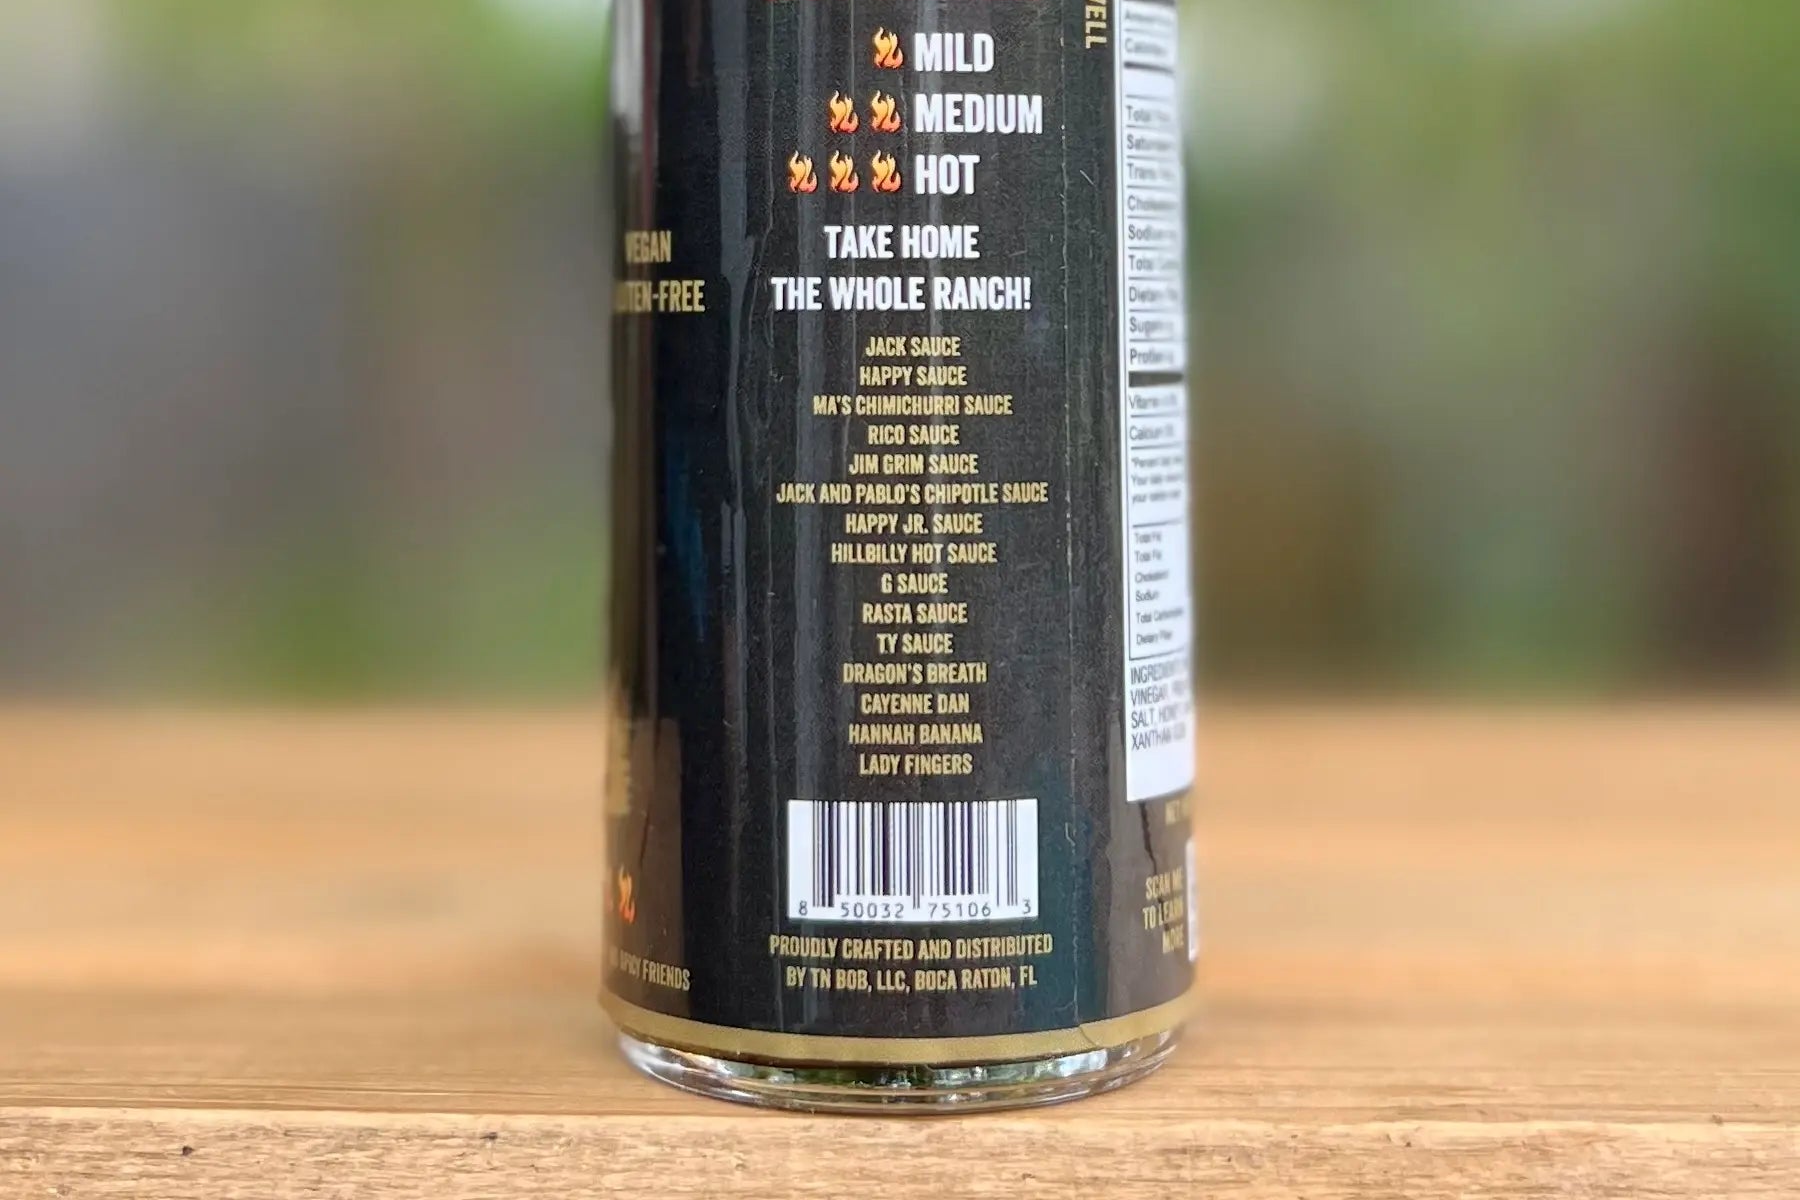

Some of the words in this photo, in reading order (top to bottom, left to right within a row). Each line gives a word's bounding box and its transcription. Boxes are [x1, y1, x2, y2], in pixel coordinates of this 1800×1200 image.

[913, 31, 995, 73] MILD
[913, 92, 1043, 135] MEDIUM
[914, 153, 981, 195] HOT
[625, 230, 672, 263] VEGAN
[823, 224, 894, 259] TAKE
[900, 224, 981, 259] HOME
[770, 276, 823, 311] THE
[828, 275, 926, 311] WHOLE
[931, 275, 1031, 311] RANCH!
[865, 335, 907, 357] JACK
[910, 336, 960, 357] SAUCE
[859, 365, 913, 386] HAPPY
[916, 365, 967, 387] SAUCE
[813, 395, 852, 416] MA'S
[854, 394, 960, 416] CHIMICHURRI
[963, 394, 1012, 416] SAUCE
[867, 424, 906, 445] RICO
[908, 424, 960, 446] SAUCE
[849, 453, 879, 475] JIM
[882, 453, 924, 475] GRIM
[928, 453, 977, 475] SAUCE
[777, 483, 815, 504] JACK
[819, 483, 852, 504] AND
[855, 483, 921, 505] PABLO'S
[923, 483, 999, 505] CHIPOTLE
[1002, 482, 1047, 504] SAUCE
[845, 513, 899, 535] HAPPY
[902, 513, 929, 535] JR.
[932, 512, 983, 535] SAUCE
[831, 543, 908, 564] HILLBILLY
[911, 542, 944, 564] HOT
[947, 542, 998, 564] SAUCE
[881, 573, 893, 594] G
[896, 572, 949, 595] SAUCE
[862, 602, 913, 624] RASTA
[916, 602, 967, 624] SAUCE
[877, 633, 898, 653] TY
[901, 632, 953, 655] SAUCE
[843, 662, 923, 685] DRAGON'S
[926, 662, 987, 684] BREATH
[861, 693, 933, 715] CAYENNE
[936, 693, 970, 714] DAN
[848, 723, 915, 745] HANNAH
[919, 723, 983, 745] BANANA
[859, 753, 901, 775] LADY
[904, 753, 973, 775] FINGERS
[1146, 872, 1171, 901] SCAN
[798, 901, 808, 916] 8
[840, 902, 904, 919] 50032
[928, 902, 992, 918] 75106
[1022, 899, 1032, 915] 3
[1143, 906, 1157, 931] TO
[770, 935, 838, 958] PROUDLY
[842, 937, 914, 961] CRAFTED
[917, 938, 952, 961] AND
[955, 934, 1053, 957] DISTRIBUTED
[642, 959, 691, 991] FRIENDS
[785, 966, 806, 987] BY
[812, 968, 832, 989] TN
[835, 967, 873, 993] BOB,
[876, 969, 910, 993] LLC,
[914, 969, 957, 991] BOCA
[961, 966, 1015, 991] RATON,
[1018, 966, 1037, 987] FL
